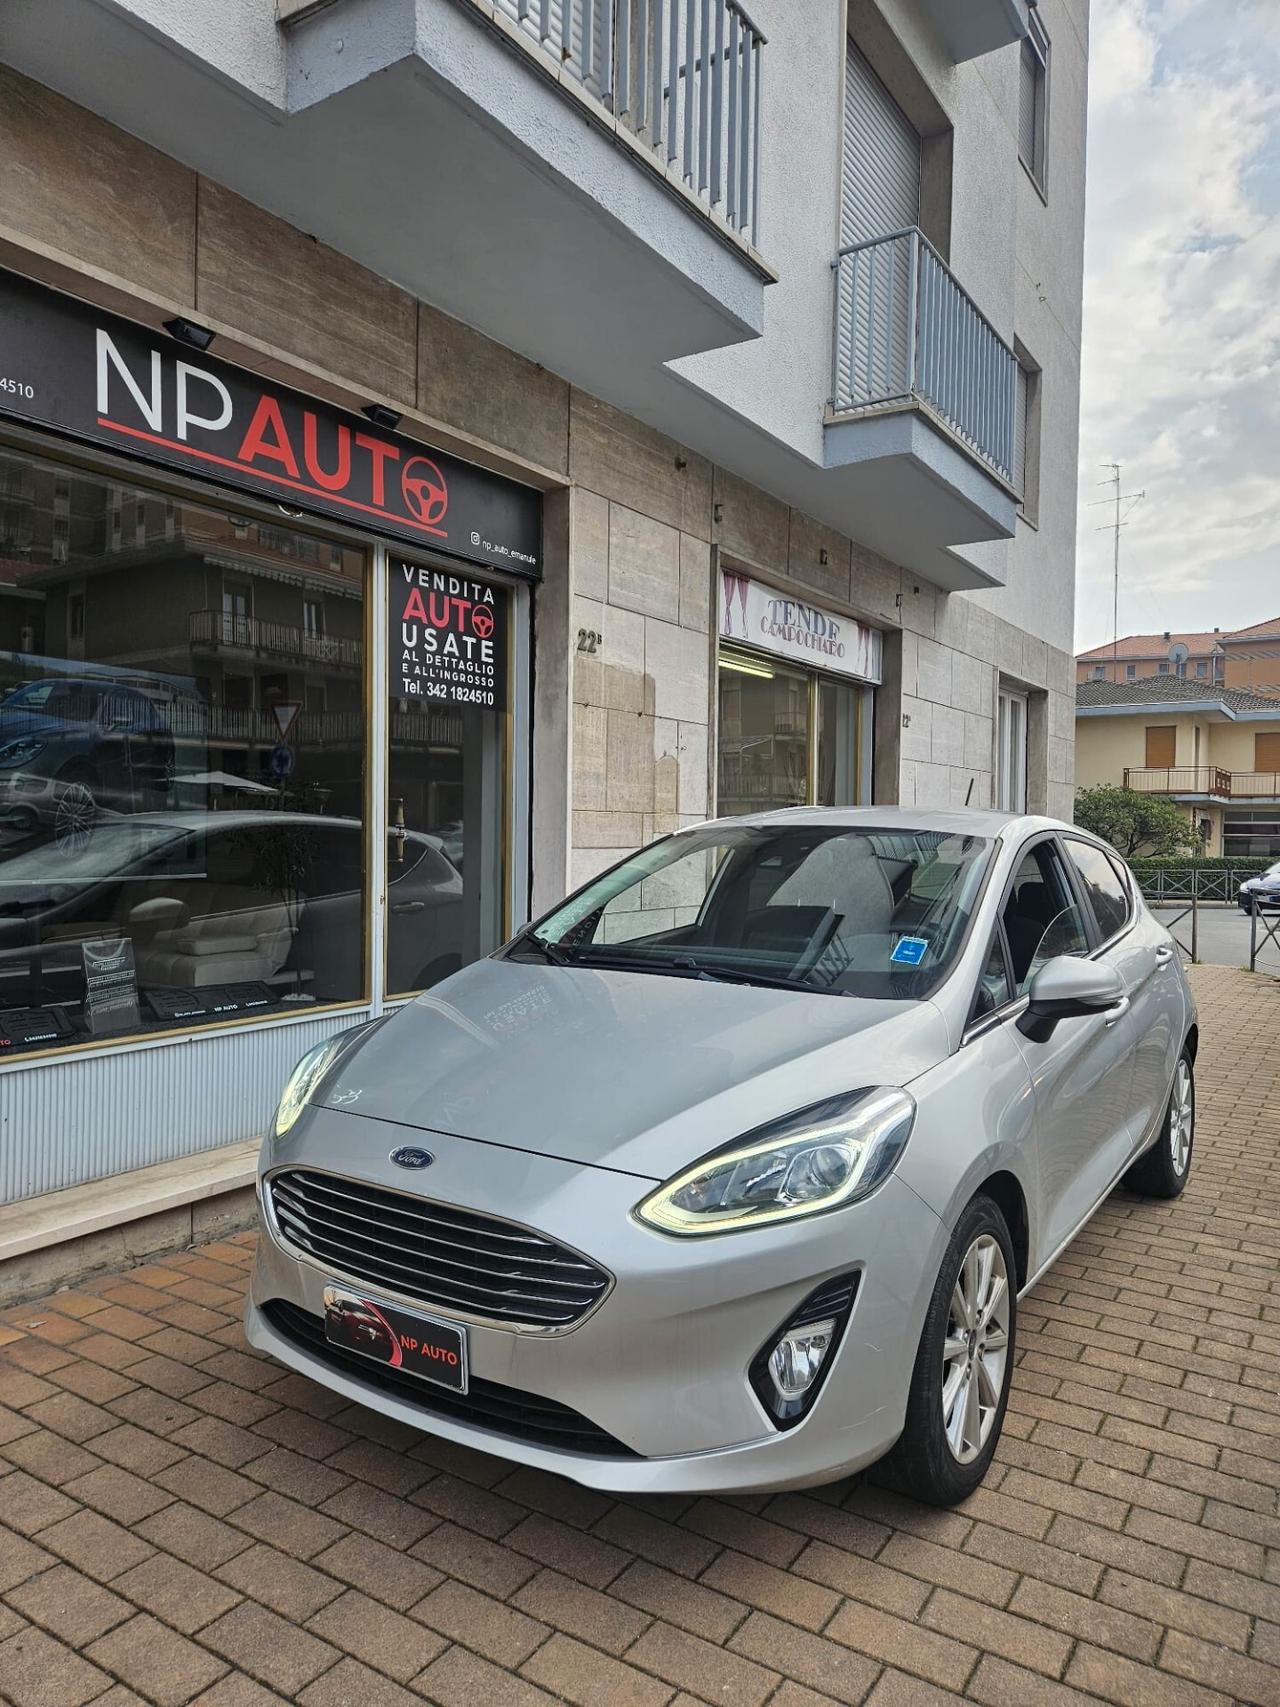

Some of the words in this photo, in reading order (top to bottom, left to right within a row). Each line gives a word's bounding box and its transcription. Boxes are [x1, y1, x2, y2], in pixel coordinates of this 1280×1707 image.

[97, 328, 233, 441] NP
[402, 563, 495, 606] VENDITA
[402, 622, 495, 664] USATE
[402, 649, 420, 662] AL
[426, 653, 495, 676] DETTAGLIO
[402, 663, 409, 673] E
[414, 665, 495, 688] ALL'INGROSSO
[402, 678, 424, 695] Tel.
[427, 682, 448, 699] 342
[450, 686, 495, 706] 1824510
[397, 1151, 427, 1165] Ford
[400, 1334, 418, 1351] NP
[421, 1342, 459, 1366] AUTO
